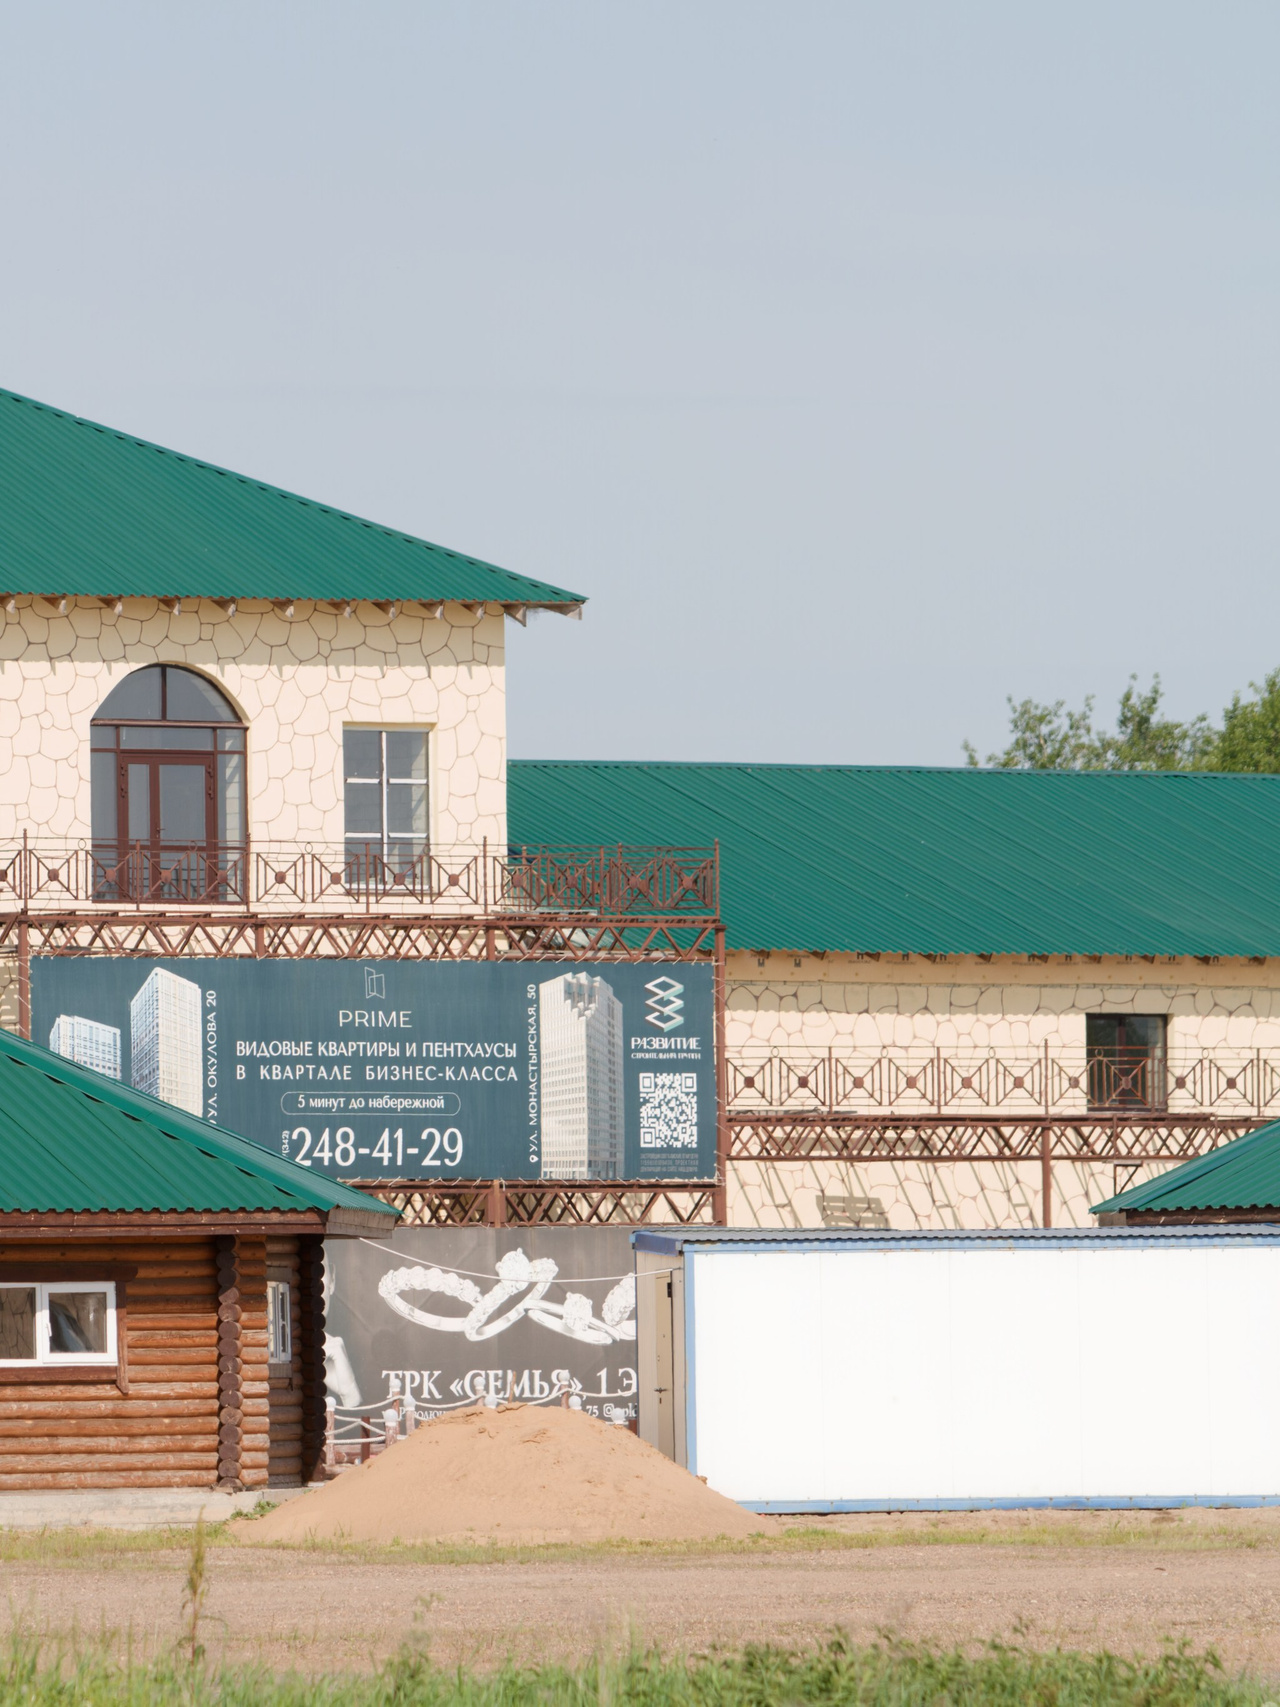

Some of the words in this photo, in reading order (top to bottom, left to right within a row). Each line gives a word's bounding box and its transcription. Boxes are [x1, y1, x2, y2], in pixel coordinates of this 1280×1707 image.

[205, 990, 217, 1007] 20
[526, 983, 537, 1000] 50
[339, 1009, 413, 1028] PRIME
[206, 1011, 218, 1088] ОКУЛОВА
[236, 1040, 313, 1058] ВИДОВЫЕ
[317, 1041, 400, 1058] КВАРТИРЫ
[405, 1042, 417, 1058] И
[422, 1041, 517, 1058] ПЕНТХАУСЫ
[630, 1036, 702, 1050] РАЗВИТИЕ
[236, 1064, 247, 1081] В
[259, 1064, 352, 1081] КВАРТАЛЕ
[365, 1065, 518, 1082] БИЗНЕС-КЛАССА
[527, 1004, 538, 1126] МОНАСТЫРСКАЯ,
[207, 1092, 218, 1118] УЛ.
[297, 1094, 306, 1109] 5
[309, 1096, 346, 1112] минут
[348, 1097, 366, 1110] до
[368, 1094, 445, 1112] набережной
[291, 1126, 464, 1167] 248-41-29
[528, 1130, 538, 1152] УЛ.
[381, 1370, 442, 1399] ТРК
[596, 1367, 608, 1397] 1
